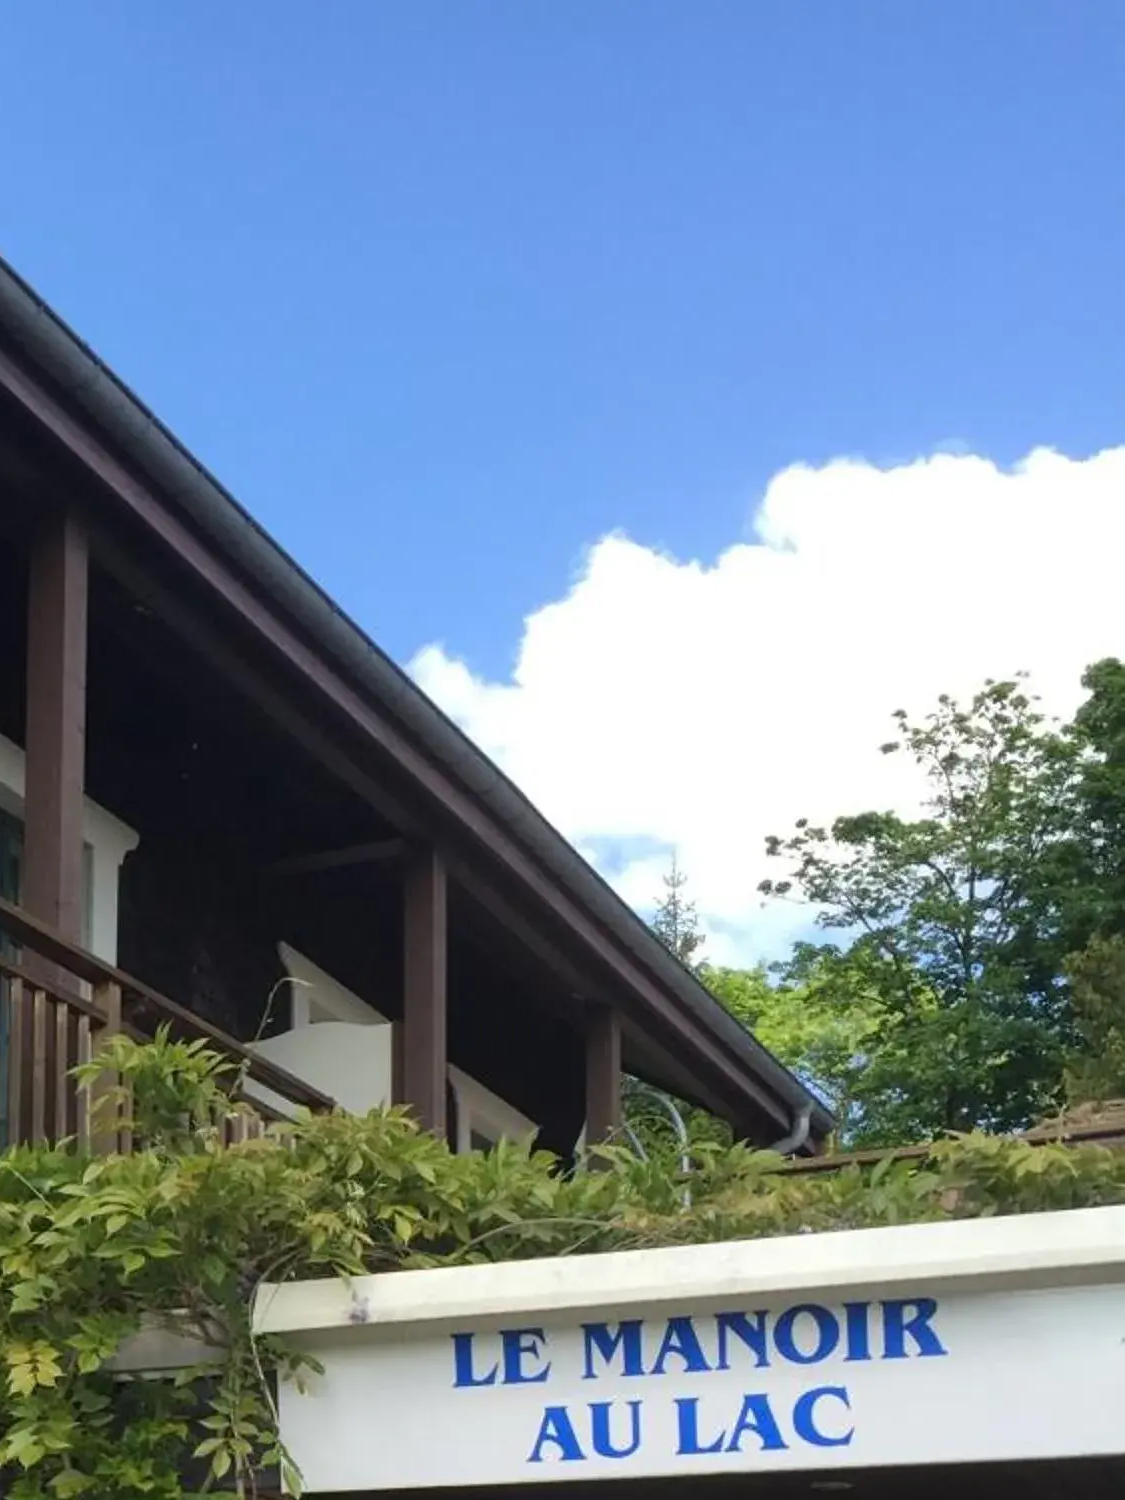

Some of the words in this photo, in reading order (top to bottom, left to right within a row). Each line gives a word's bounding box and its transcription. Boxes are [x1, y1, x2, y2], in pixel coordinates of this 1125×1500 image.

[451, 1327, 550, 1388] LE
[579, 1297, 947, 1380] MANOIR
[527, 1401, 643, 1463] AU
[673, 1386, 854, 1457] LAC
